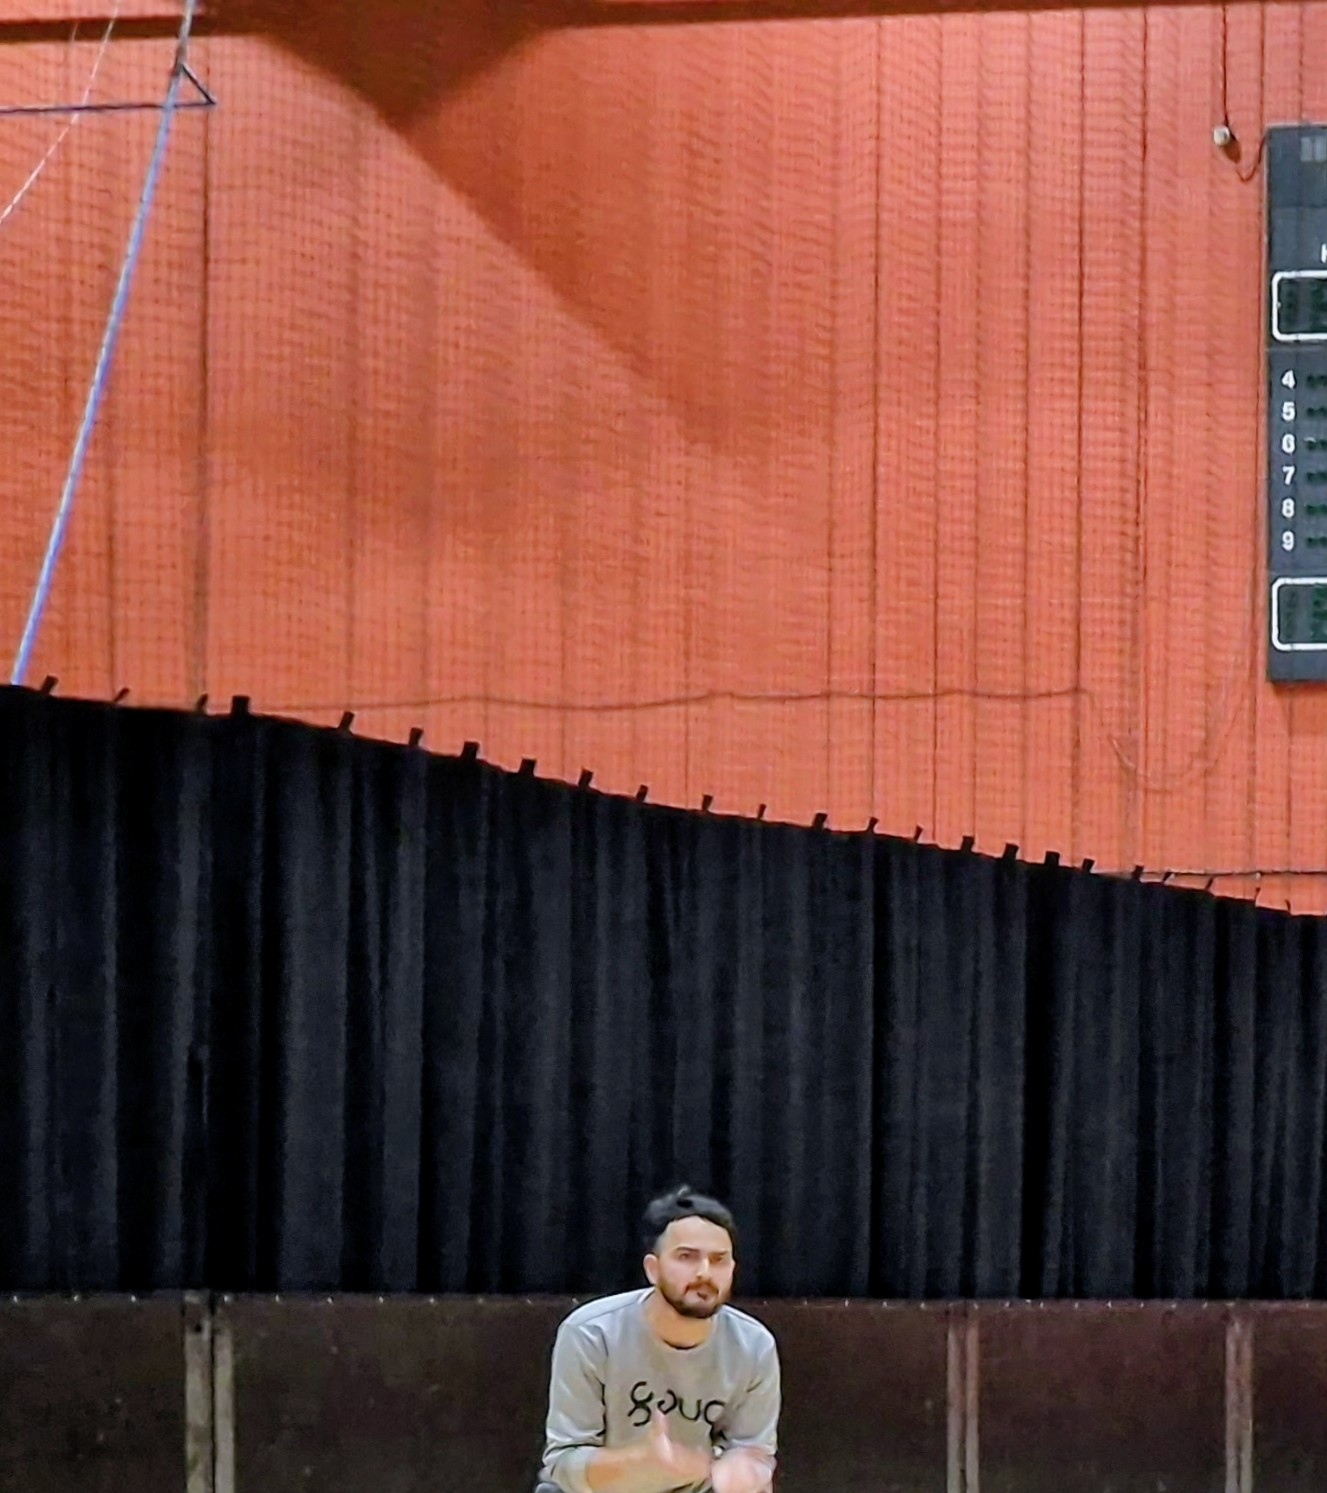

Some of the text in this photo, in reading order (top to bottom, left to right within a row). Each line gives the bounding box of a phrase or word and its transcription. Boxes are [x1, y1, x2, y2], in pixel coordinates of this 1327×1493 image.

[1281, 370, 1296, 389] 4
[1281, 401, 1296, 422] 5
[1281, 433, 1296, 454] 6
[1282, 465, 1295, 486] 7
[1281, 497, 1295, 519] 8
[1282, 530, 1295, 551] 9
